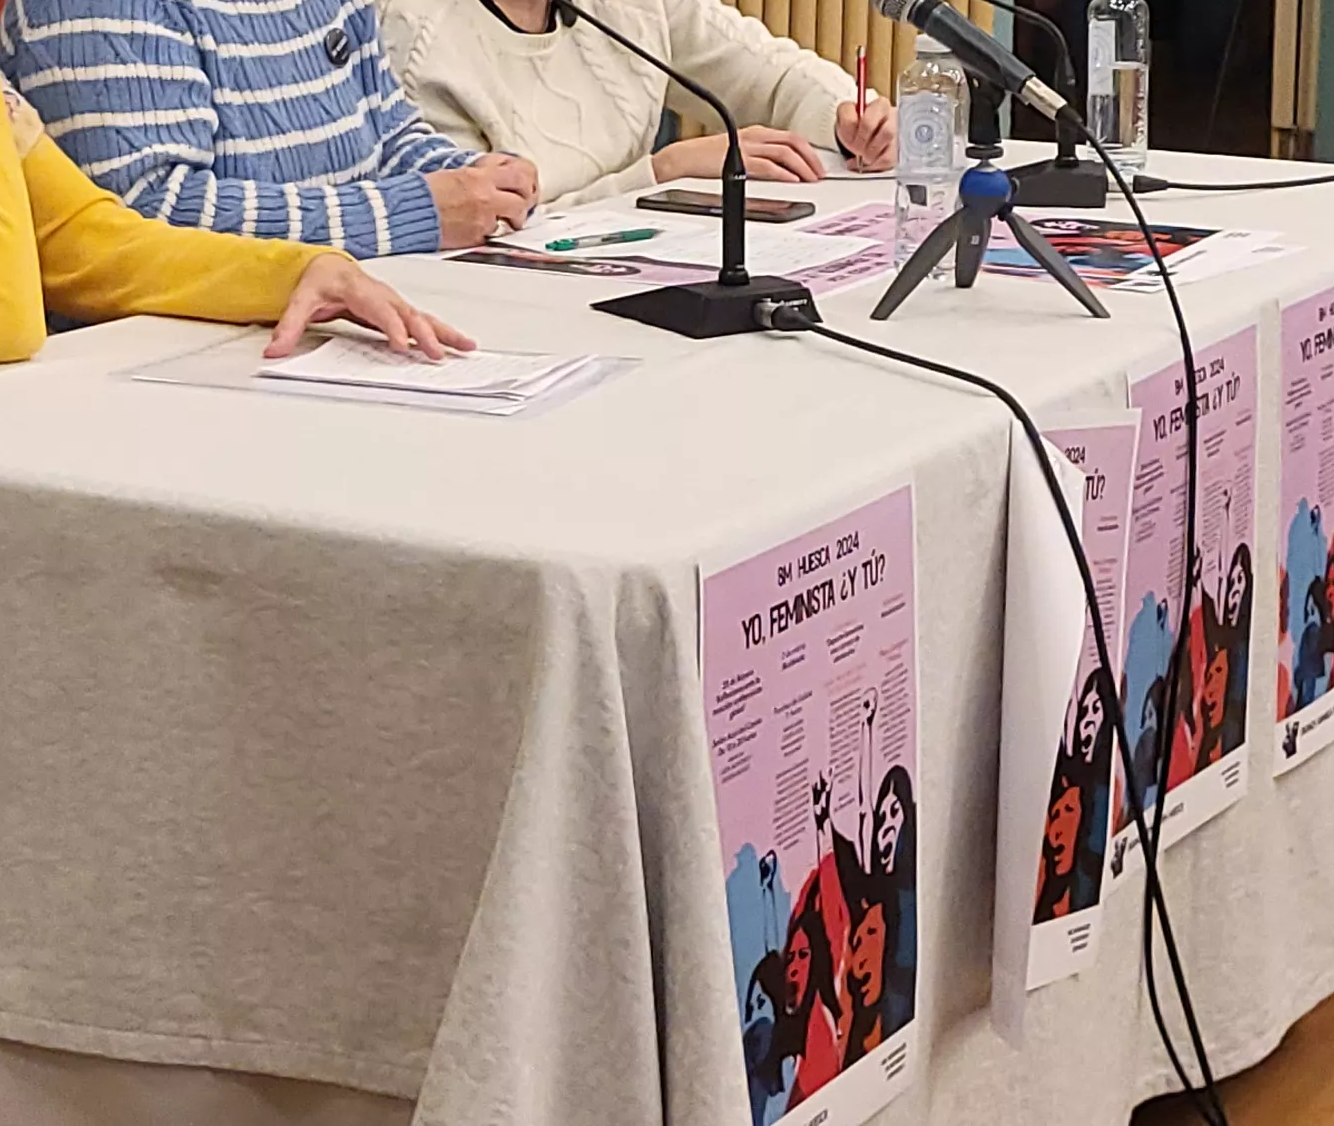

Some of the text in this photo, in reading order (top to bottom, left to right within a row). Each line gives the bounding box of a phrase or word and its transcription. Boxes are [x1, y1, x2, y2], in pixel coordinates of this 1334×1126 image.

[798, 545, 830, 578] HUESCA
[836, 531, 859, 559] 2024
[862, 548, 886, 589] TÚ?
